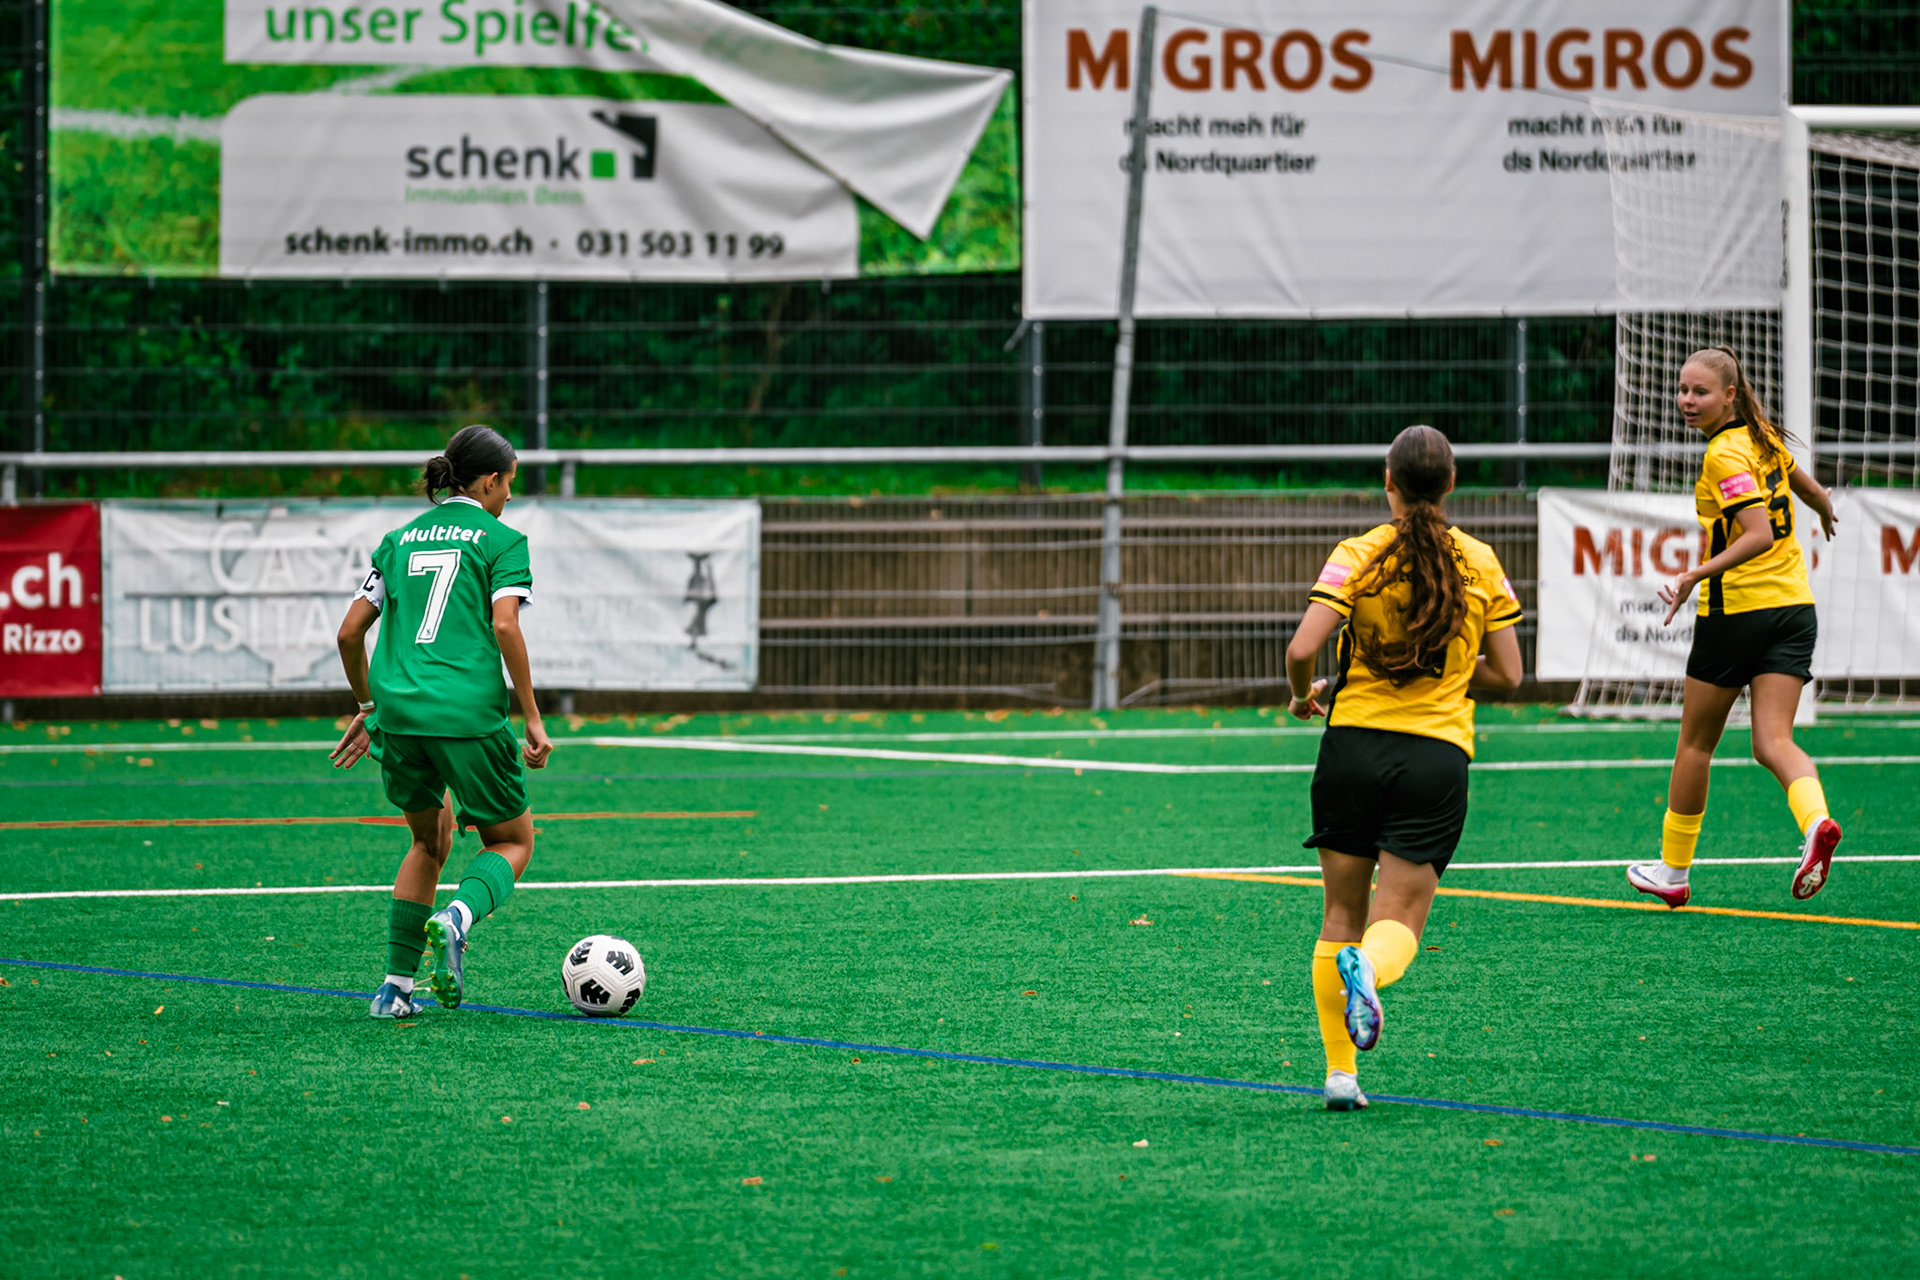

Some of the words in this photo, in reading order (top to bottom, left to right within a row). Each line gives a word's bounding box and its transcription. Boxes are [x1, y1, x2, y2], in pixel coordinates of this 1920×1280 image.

[265, 6, 423, 44] unser
[440, 0, 648, 57] Spielfe
[1065, 27, 1375, 92] MGROS
[1450, 26, 1754, 91] MIGROS
[1208, 114, 1263, 136] meh
[1507, 112, 1585, 136] macht
[405, 133, 582, 180] schenk
[1155, 150, 1316, 178] Nordquartier
[1502, 150, 1532, 173] ds
[285, 226, 533, 256] schenk-immo.ch
[576, 229, 629, 257] 031
[641, 230, 694, 258] 503
[705, 231, 737, 259] 11
[749, 232, 785, 259] 99
[400, 524, 483, 547] Multitel
[362, 569, 382, 593] C
[407, 548, 462, 645] 7
[3, 621, 84, 656] Rizzo
[139, 596, 337, 653] LUSITA
